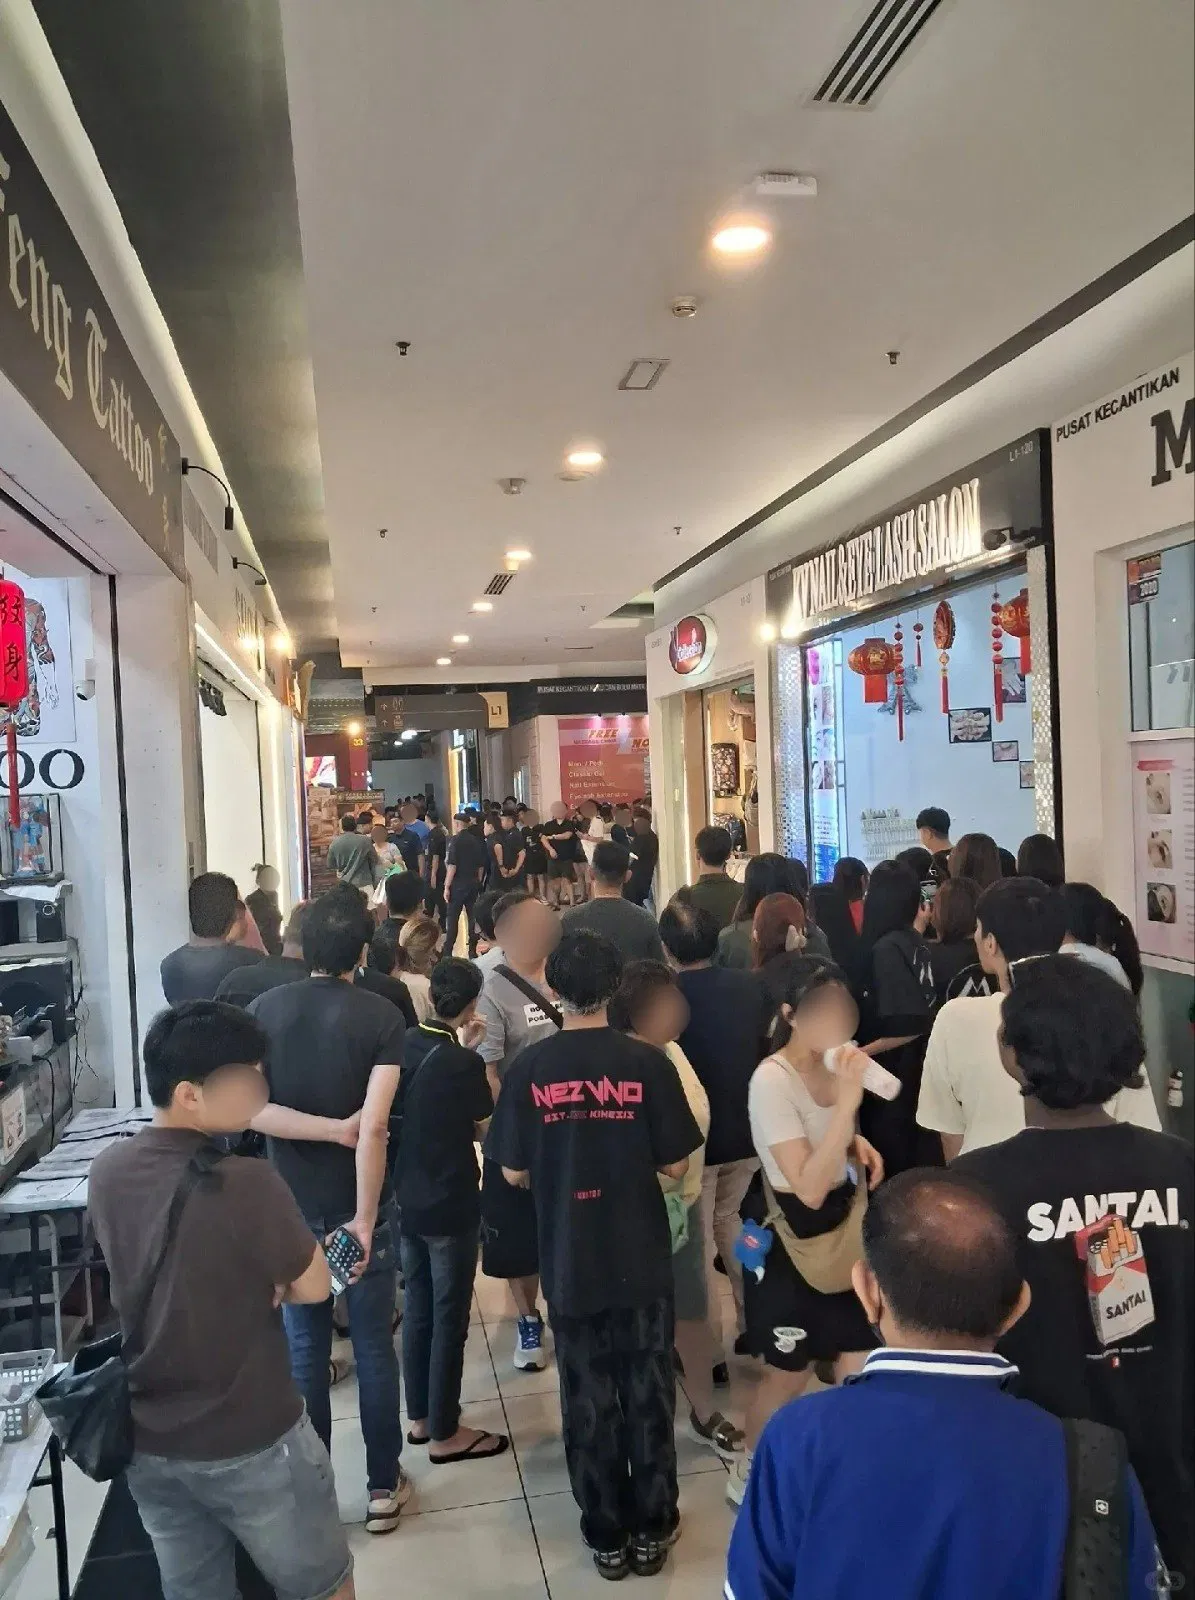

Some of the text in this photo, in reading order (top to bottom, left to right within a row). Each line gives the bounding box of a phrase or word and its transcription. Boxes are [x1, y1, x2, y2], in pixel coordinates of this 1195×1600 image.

[84, 307, 154, 496] Tattoo
[1055, 366, 1180, 442] PUSAT KECANTIKAN
[915, 477, 981, 577] SALON
[491, 705, 503, 716] L1
[1027, 1187, 1180, 1242] SANTAI
[1105, 1289, 1146, 1320] SANTAI
